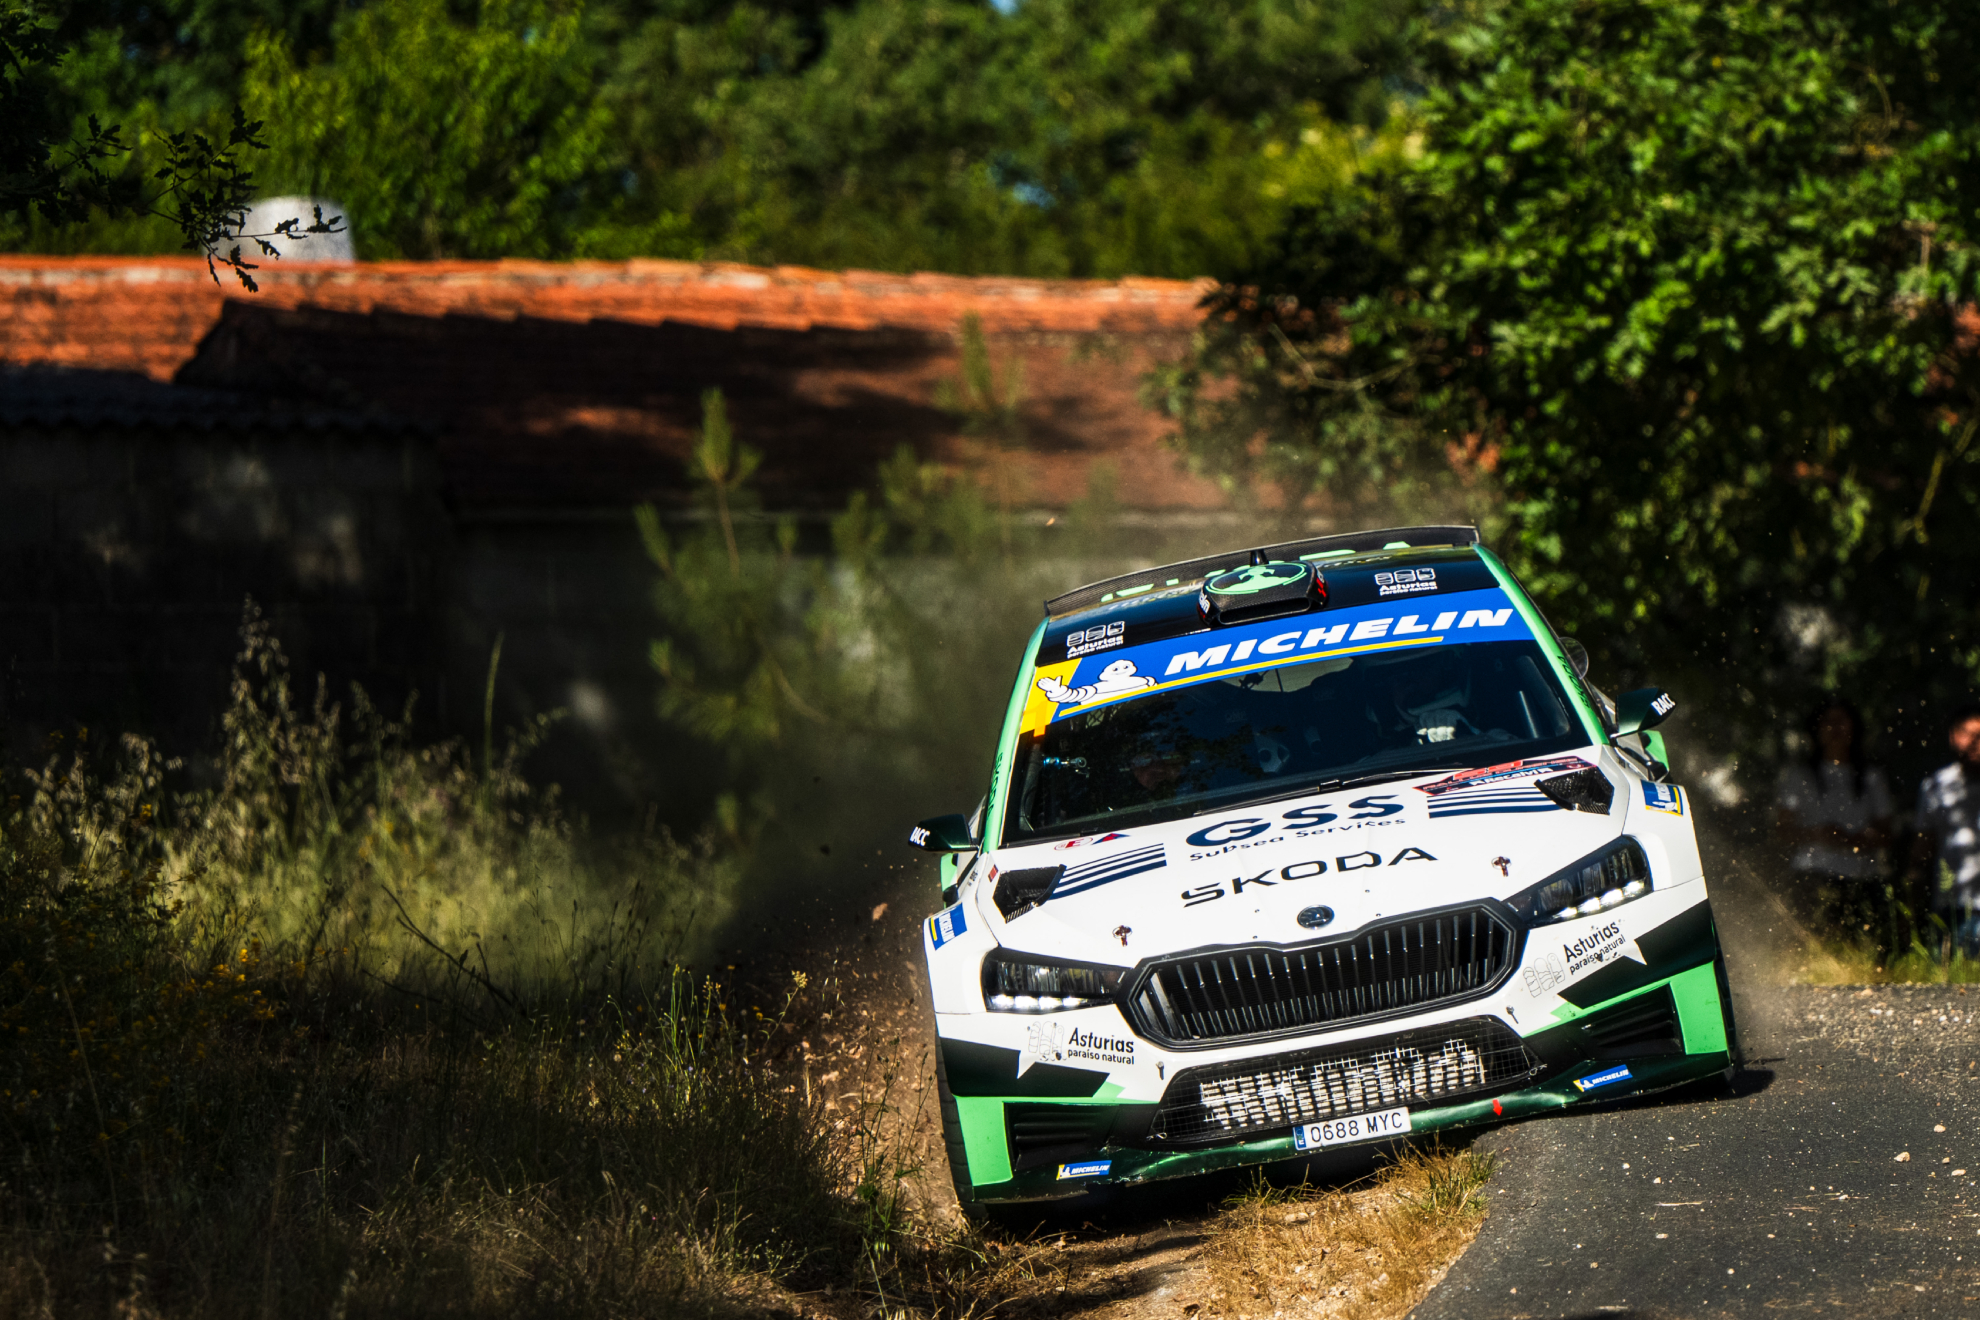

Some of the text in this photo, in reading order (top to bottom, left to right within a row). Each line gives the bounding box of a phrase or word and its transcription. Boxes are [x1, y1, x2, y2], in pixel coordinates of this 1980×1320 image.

[1379, 581, 1437, 592] Asturias
[1067, 635, 1123, 655] Asturias
[1164, 609, 1513, 676] MICHELIN
[1186, 794, 1404, 847] GSS
[1190, 819, 1405, 861] Subsea Services
[1181, 847, 1438, 907] SKODA
[1563, 921, 1620, 963] Asturias
[1599, 934, 1626, 955] natural
[1068, 1027, 1134, 1053] Asturias
[1101, 1054, 1135, 1065] natural
[1592, 1069, 1629, 1084] MICHELIN
[1310, 1119, 1359, 1143] 0688
[1366, 1112, 1402, 1133] MYC
[1071, 1164, 1110, 1174] MICHELIN
